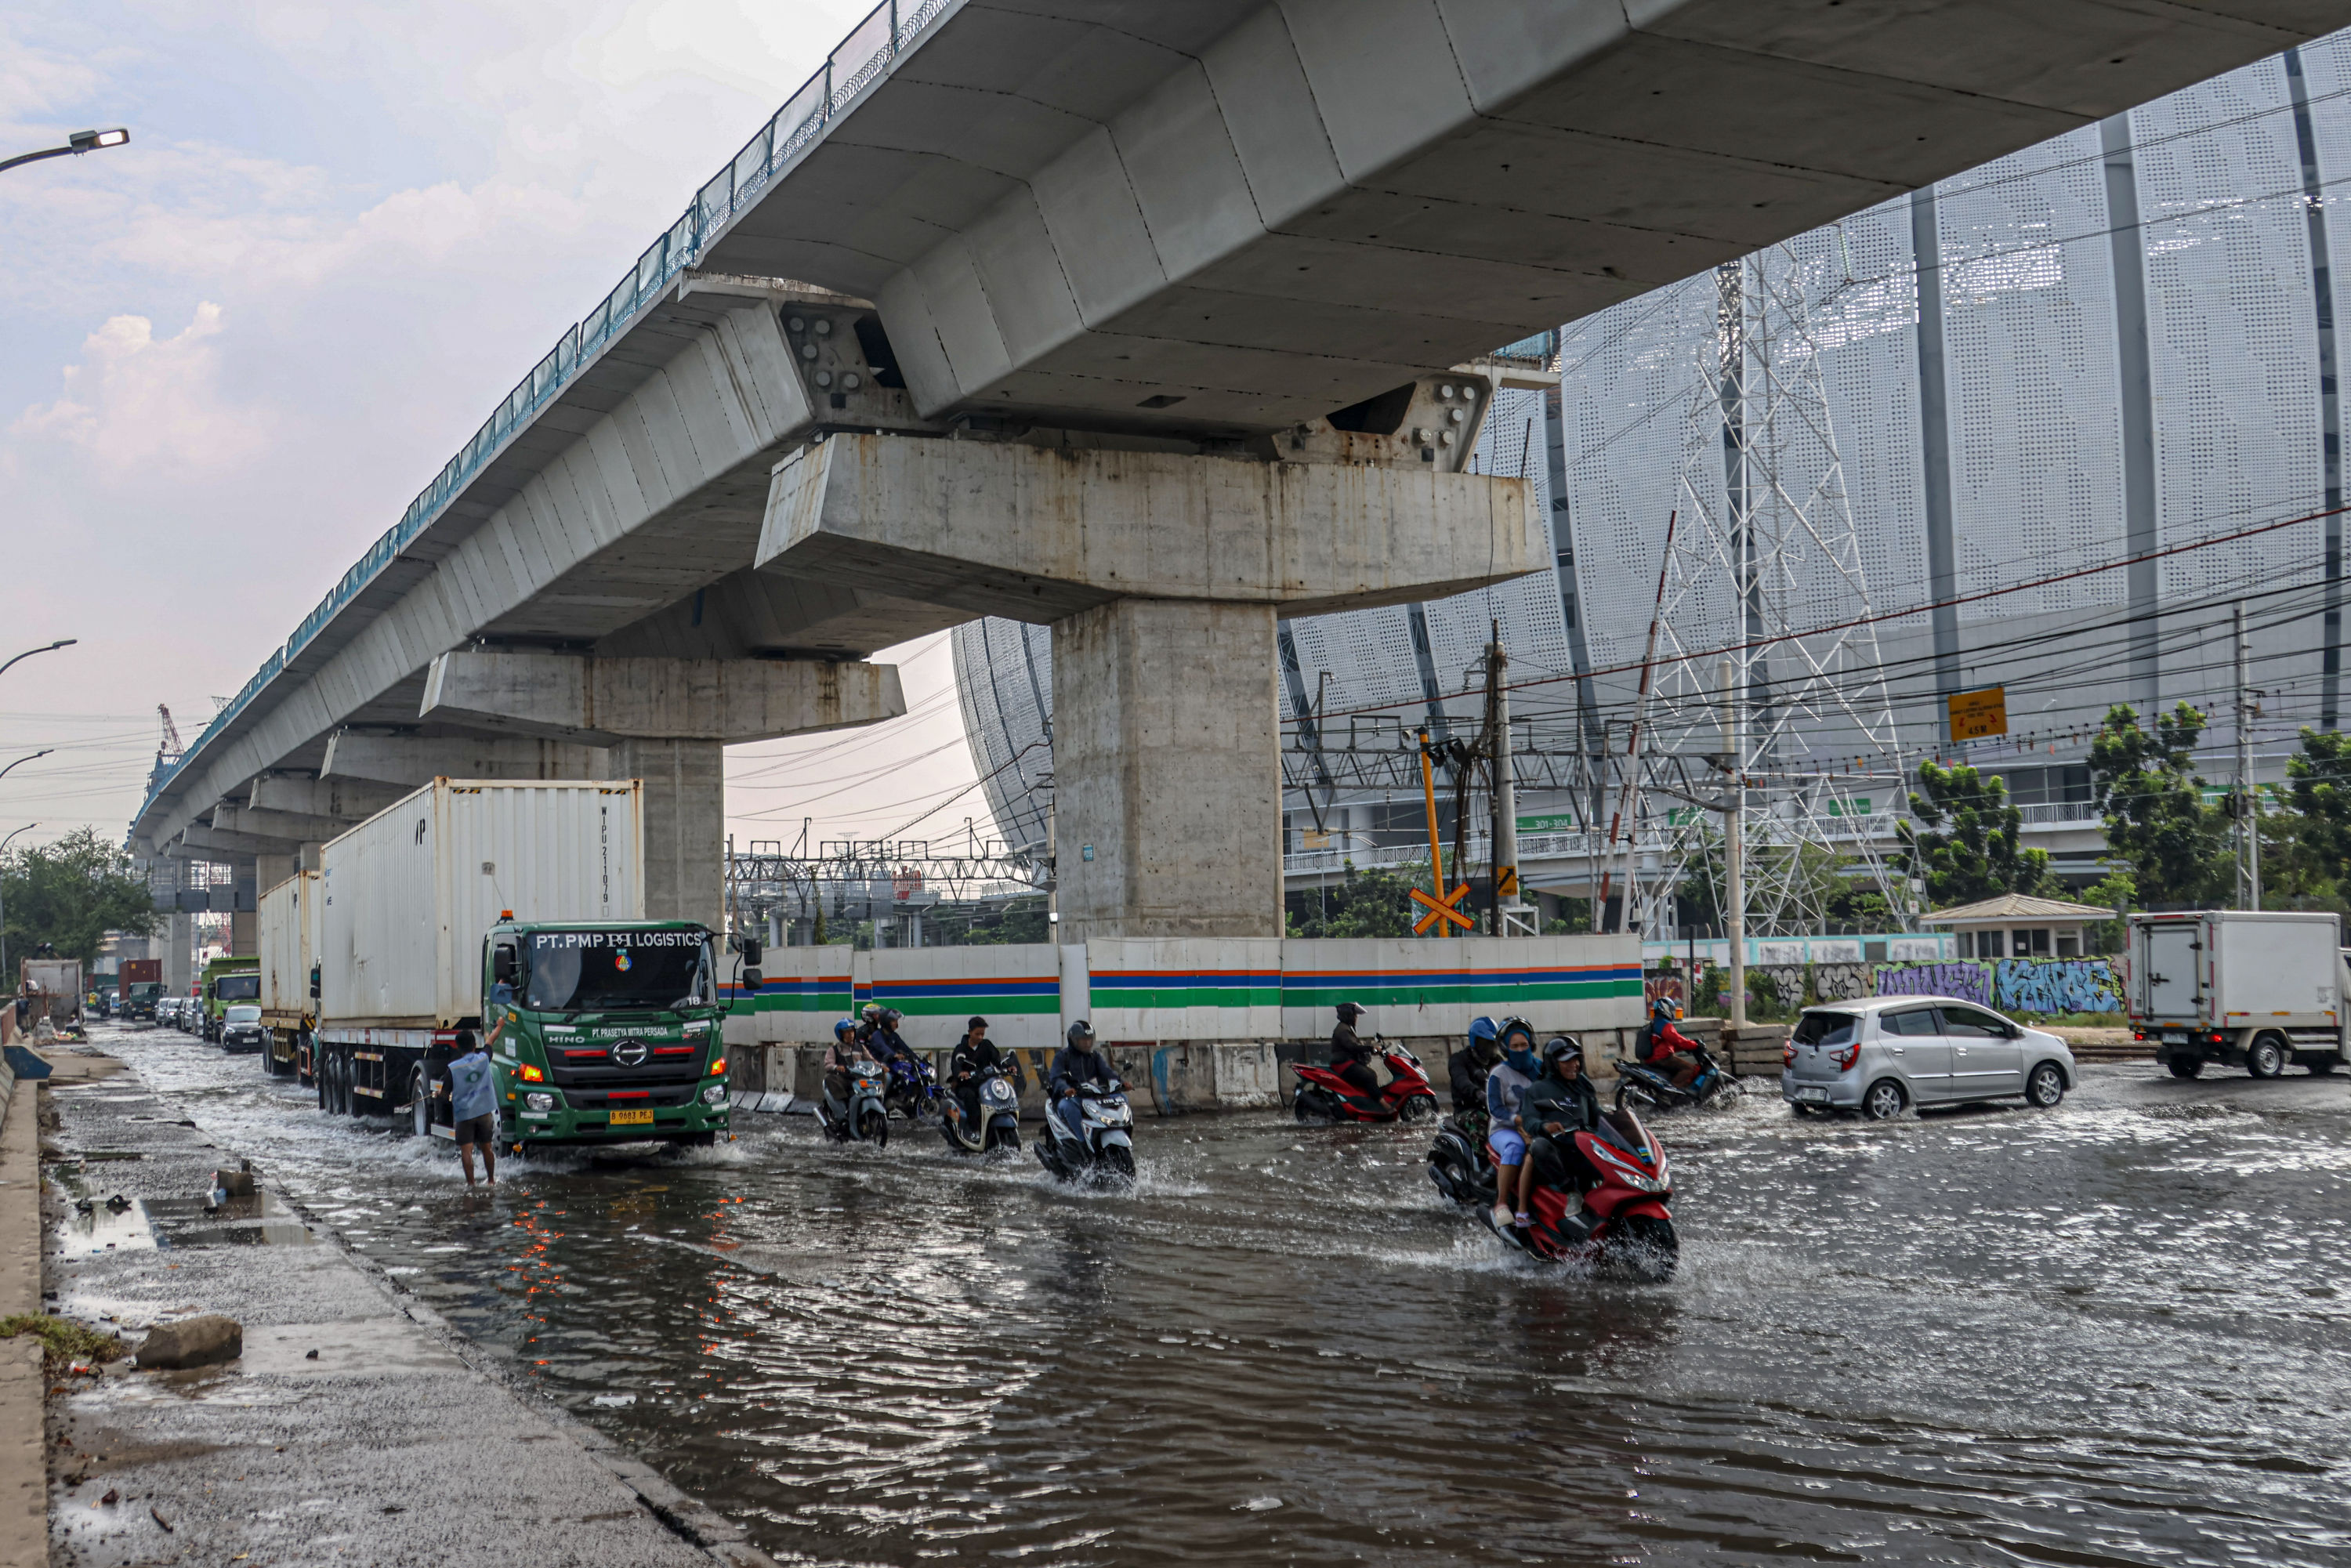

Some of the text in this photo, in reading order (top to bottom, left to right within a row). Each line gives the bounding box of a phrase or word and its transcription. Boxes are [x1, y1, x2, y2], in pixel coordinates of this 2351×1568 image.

[636, 932, 702, 947] LOGISTICS
[686, 996, 701, 1006] 18
[600, 1027, 628, 1038] PRASETYA
[627, 1027, 644, 1037] MITRA
[643, 1027, 668, 1037] PERSADA
